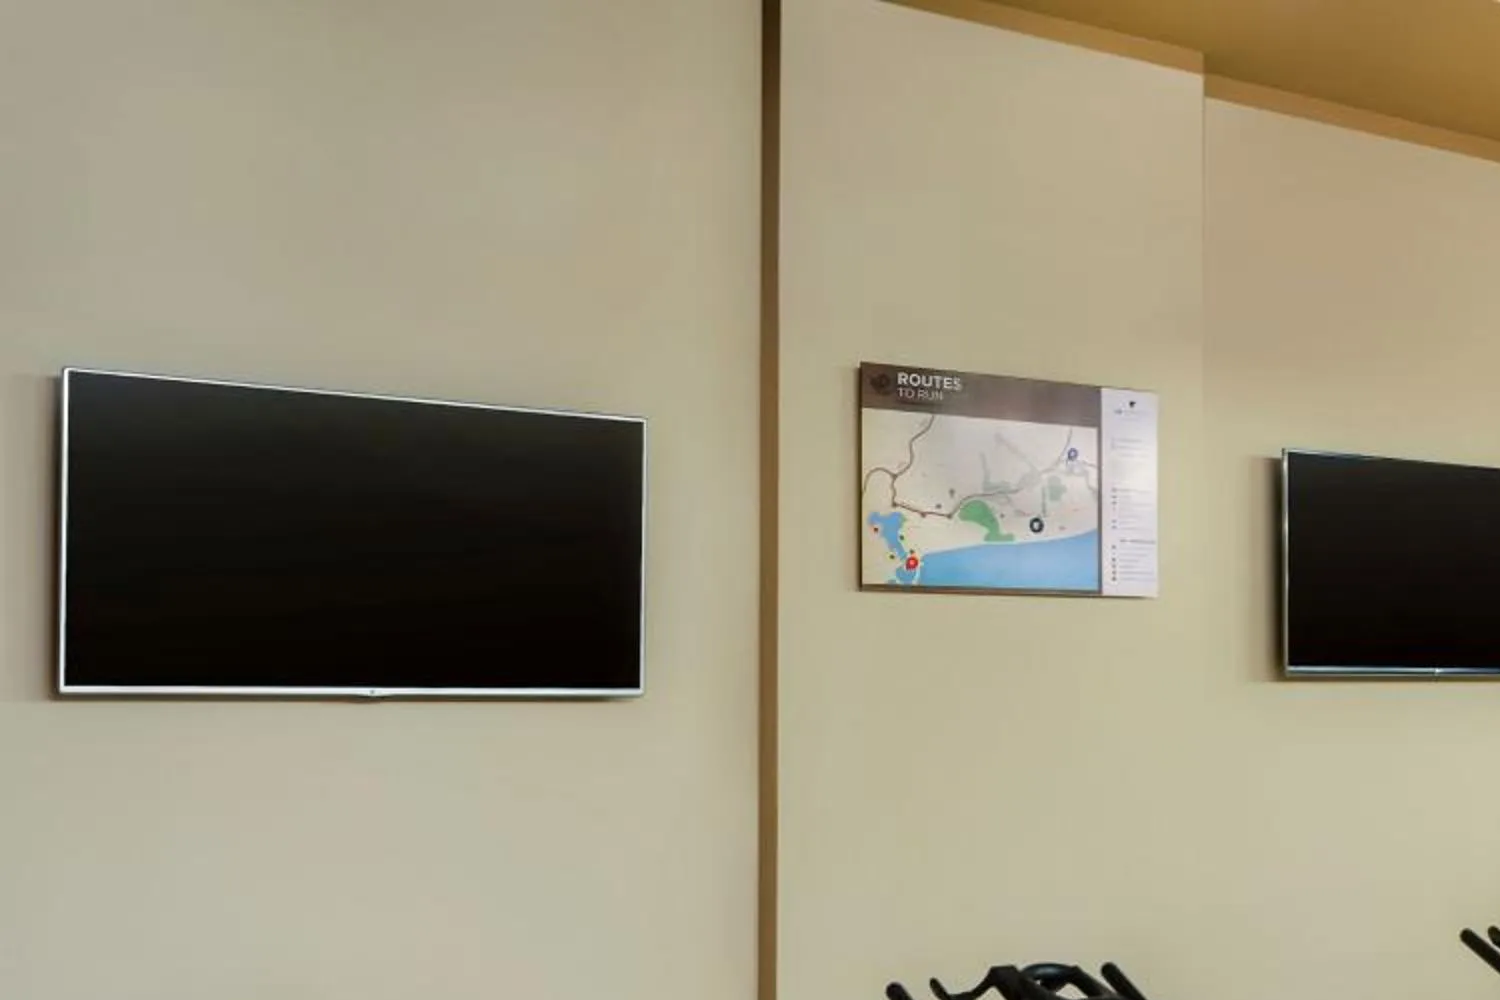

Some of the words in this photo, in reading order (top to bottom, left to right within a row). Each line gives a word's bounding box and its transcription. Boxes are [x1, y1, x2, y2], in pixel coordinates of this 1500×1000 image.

[897, 372, 962, 391] ROUTES
[897, 387, 915, 399] TO
[917, 389, 943, 401] RUN
